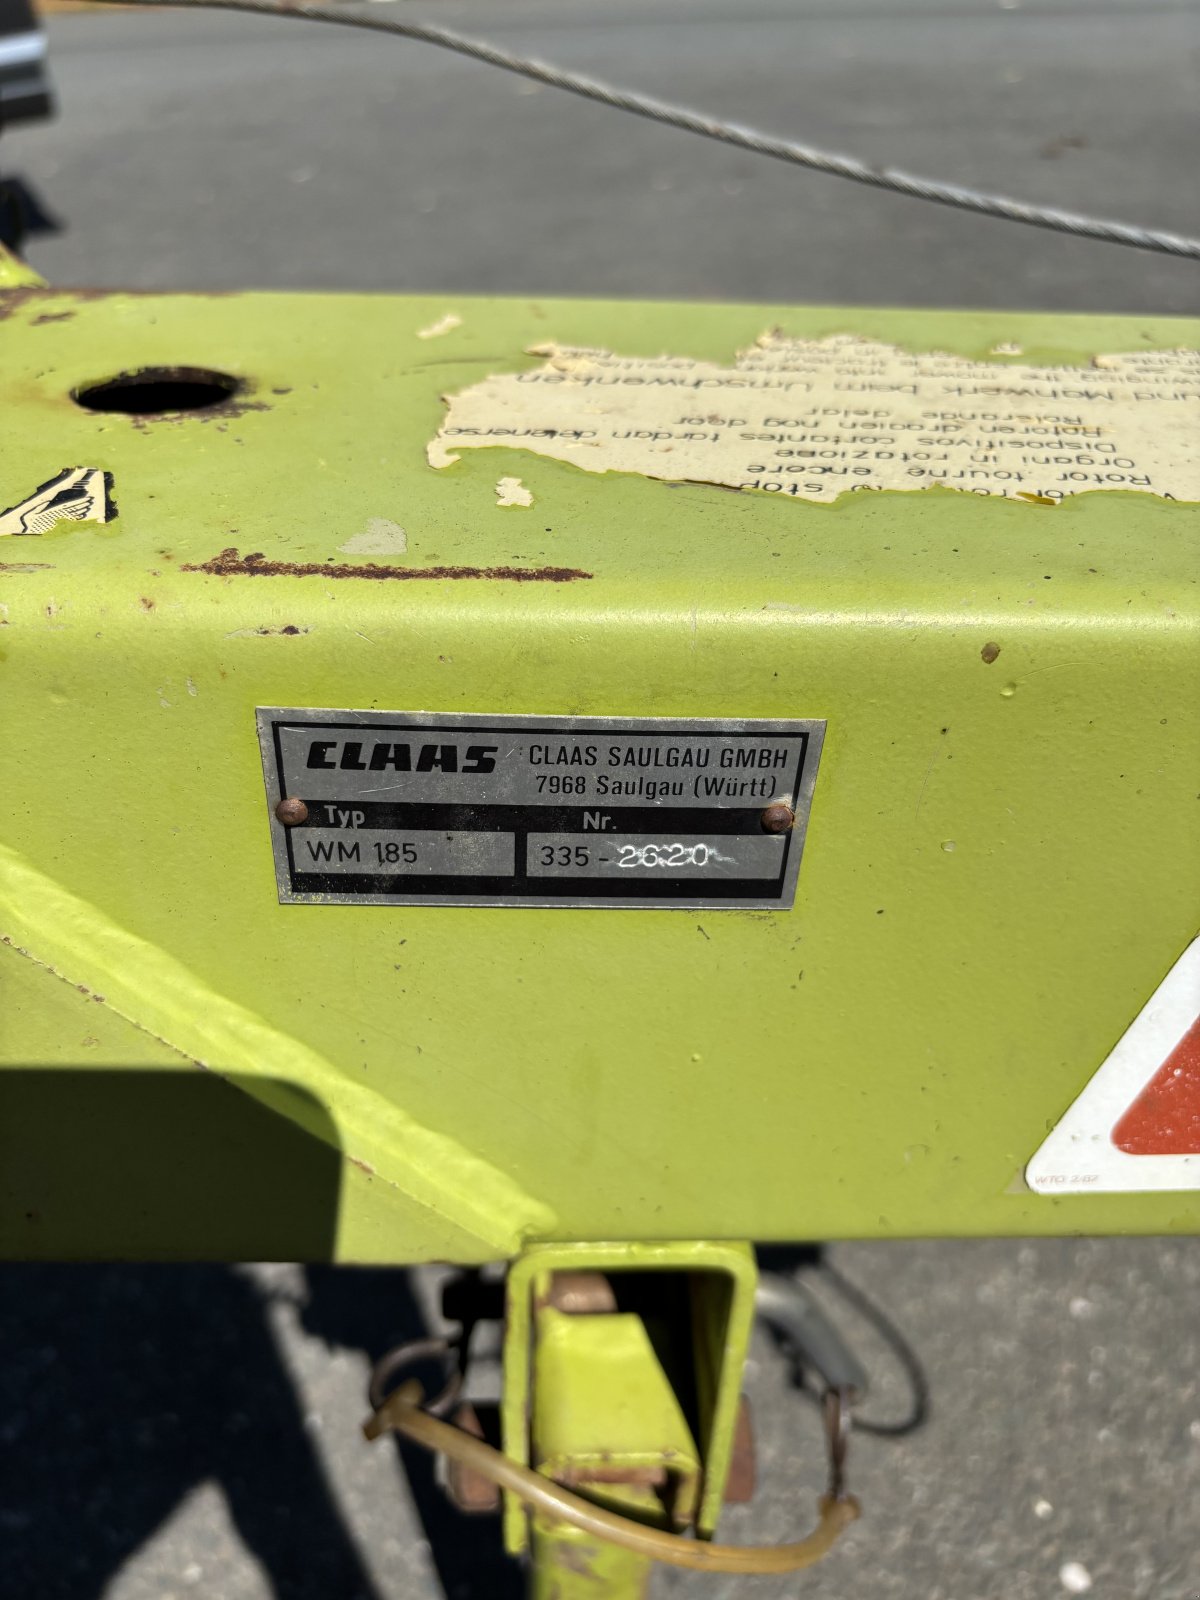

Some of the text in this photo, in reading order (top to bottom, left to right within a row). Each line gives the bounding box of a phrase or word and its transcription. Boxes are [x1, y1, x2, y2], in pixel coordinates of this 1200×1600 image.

[514, 375, 813, 393] Umschwenken
[833, 382, 918, 396] beim
[804, 407, 891, 420] delar
[672, 416, 1102, 438] Rotoren draaien nog door
[443, 428, 1117, 453] Dispositivos cortantes tardan detenerse
[774, 449, 1135, 469] Organi in rotazione
[746, 464, 1151, 486] Rotor tourne encore
[306, 741, 499, 774] CLAAS
[529, 745, 789, 770] CLAAS SAULGAU GMBH
[536, 774, 777, 800] 7968 Saulgau (Württ)
[323, 805, 365, 829] Typ
[582, 813, 617, 830] Nr.
[306, 841, 418, 864] WM 185
[540, 845, 590, 867] 335
